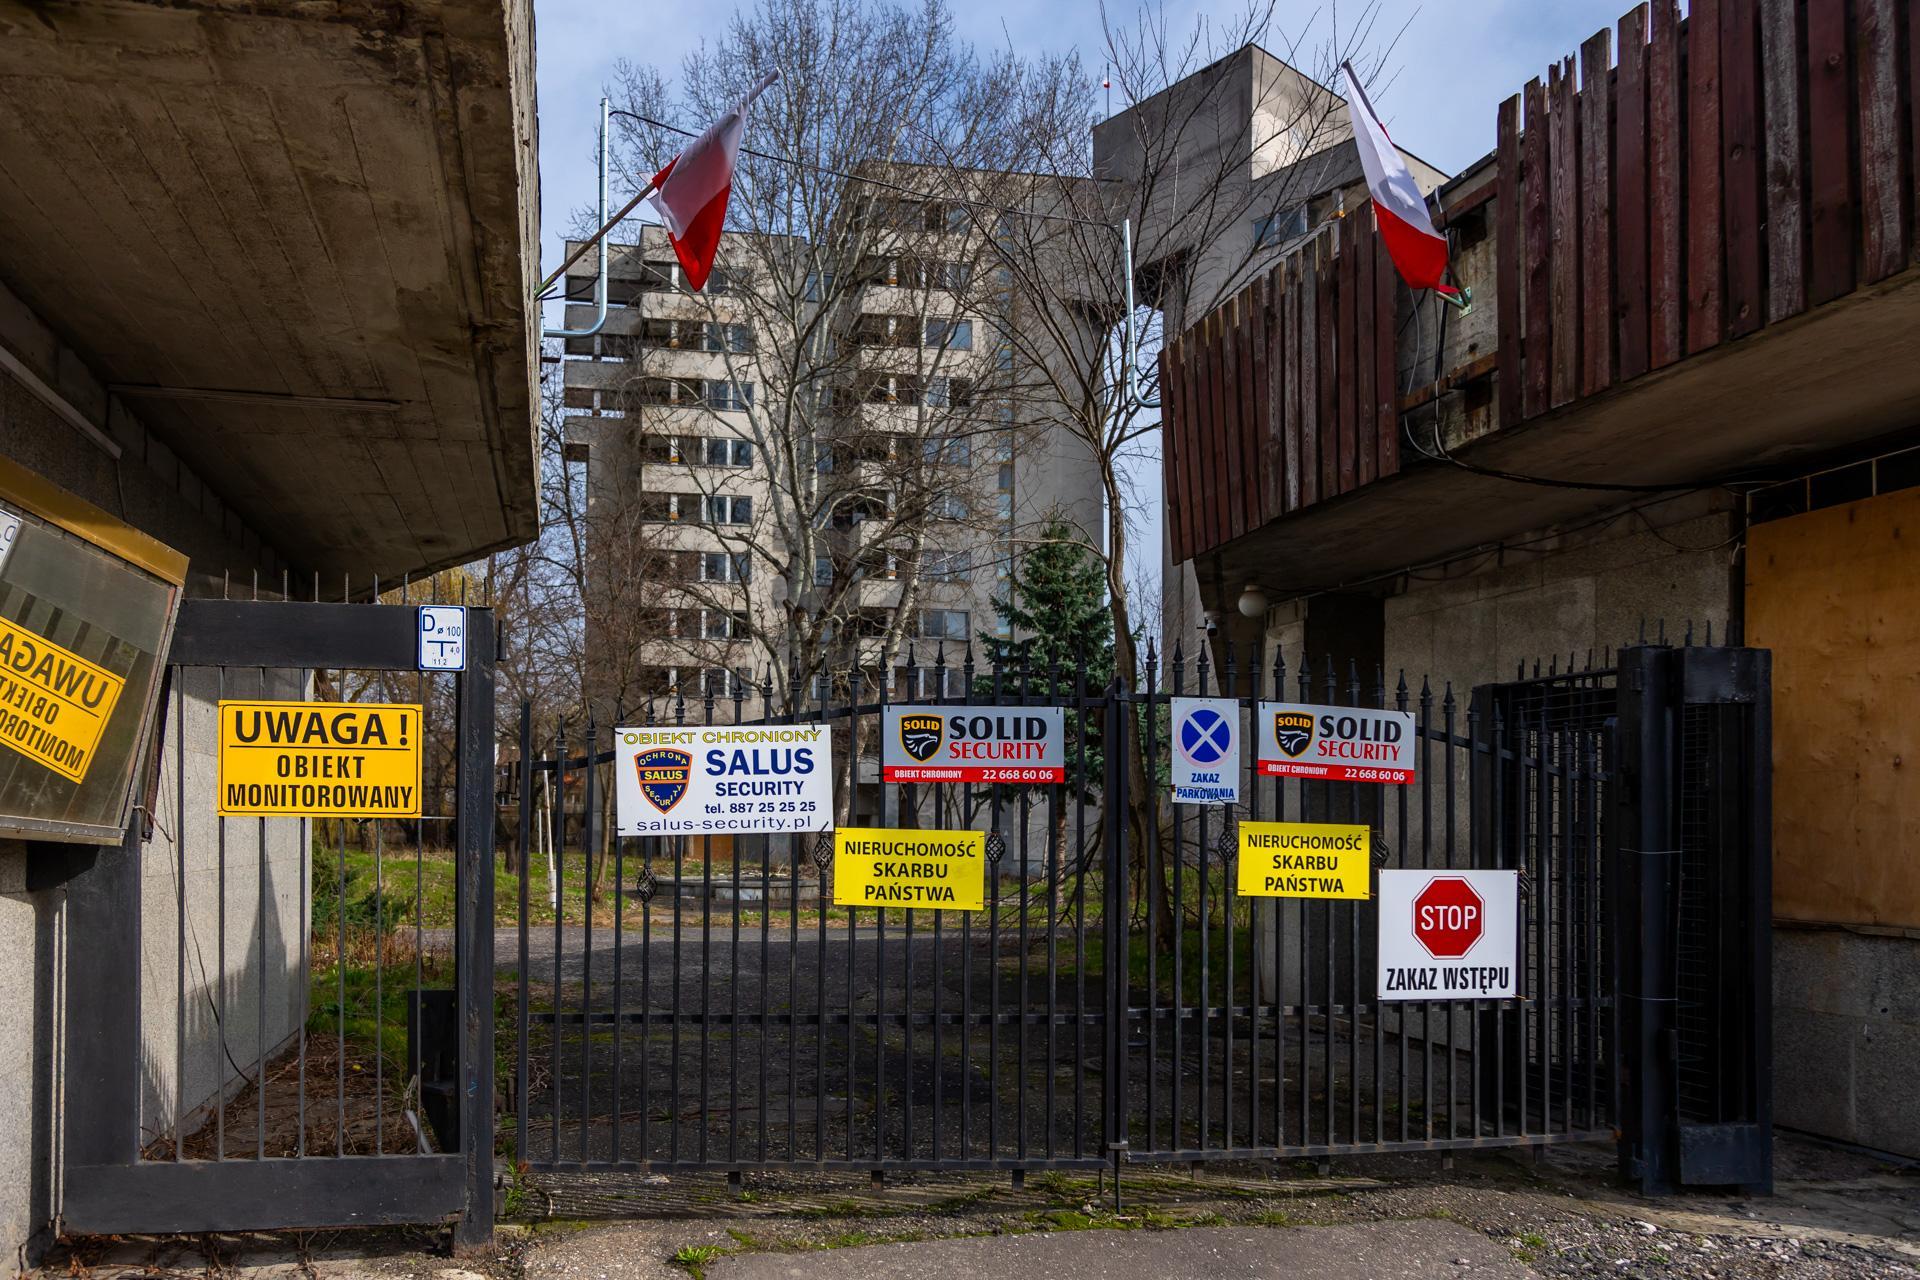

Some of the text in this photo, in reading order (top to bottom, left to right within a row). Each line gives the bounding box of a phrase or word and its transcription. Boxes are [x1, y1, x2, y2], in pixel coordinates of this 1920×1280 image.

[423, 614, 435, 631] D
[447, 627, 461, 636] 100
[235, 710, 408, 746] UWAGA !
[903, 719, 940, 731] SOLID
[949, 716, 1047, 740] SOLID
[1277, 716, 1312, 728] SOLID
[1319, 715, 1401, 743] SOLID
[623, 730, 821, 744] OBIEKT CHRONIONY
[640, 751, 687, 765] OCHRONA
[949, 742, 1047, 759] SECURITY
[1317, 740, 1401, 761] SECURITY
[277, 755, 365, 778] OBIEKT
[705, 748, 814, 776] SALUS
[1267, 764, 1328, 775] OBIEKT CHRONIONY
[644, 770, 683, 780] SALUS
[894, 770, 963, 778] OBIEKT CHRONIONY
[982, 769, 1053, 780] 22 668 60 06
[1191, 773, 1219, 783] ZAKAZ
[1344, 768, 1405, 780] 22 668 60 06
[227, 784, 412, 808] MONITOROWANY
[645, 785, 682, 806] SECURITY
[715, 781, 804, 796] SECURITY
[1176, 787, 1234, 799] PARKOWANIA
[705, 801, 816, 813] tel. 887 25 25 25
[637, 816, 811, 831] salus-security.pl
[845, 841, 976, 858] NIERUCHOMOŚĆ
[1248, 834, 1362, 850] NIERUCHOMOŚĆ
[873, 862, 948, 878] SKARBU
[1272, 855, 1338, 870] SKARBU
[1265, 874, 1344, 892] PAŃSTWA
[865, 882, 955, 901] PAŃSTWA
[1420, 905, 1477, 930] STOP
[1386, 967, 1509, 994] ZAKAZ WSTĘPU
